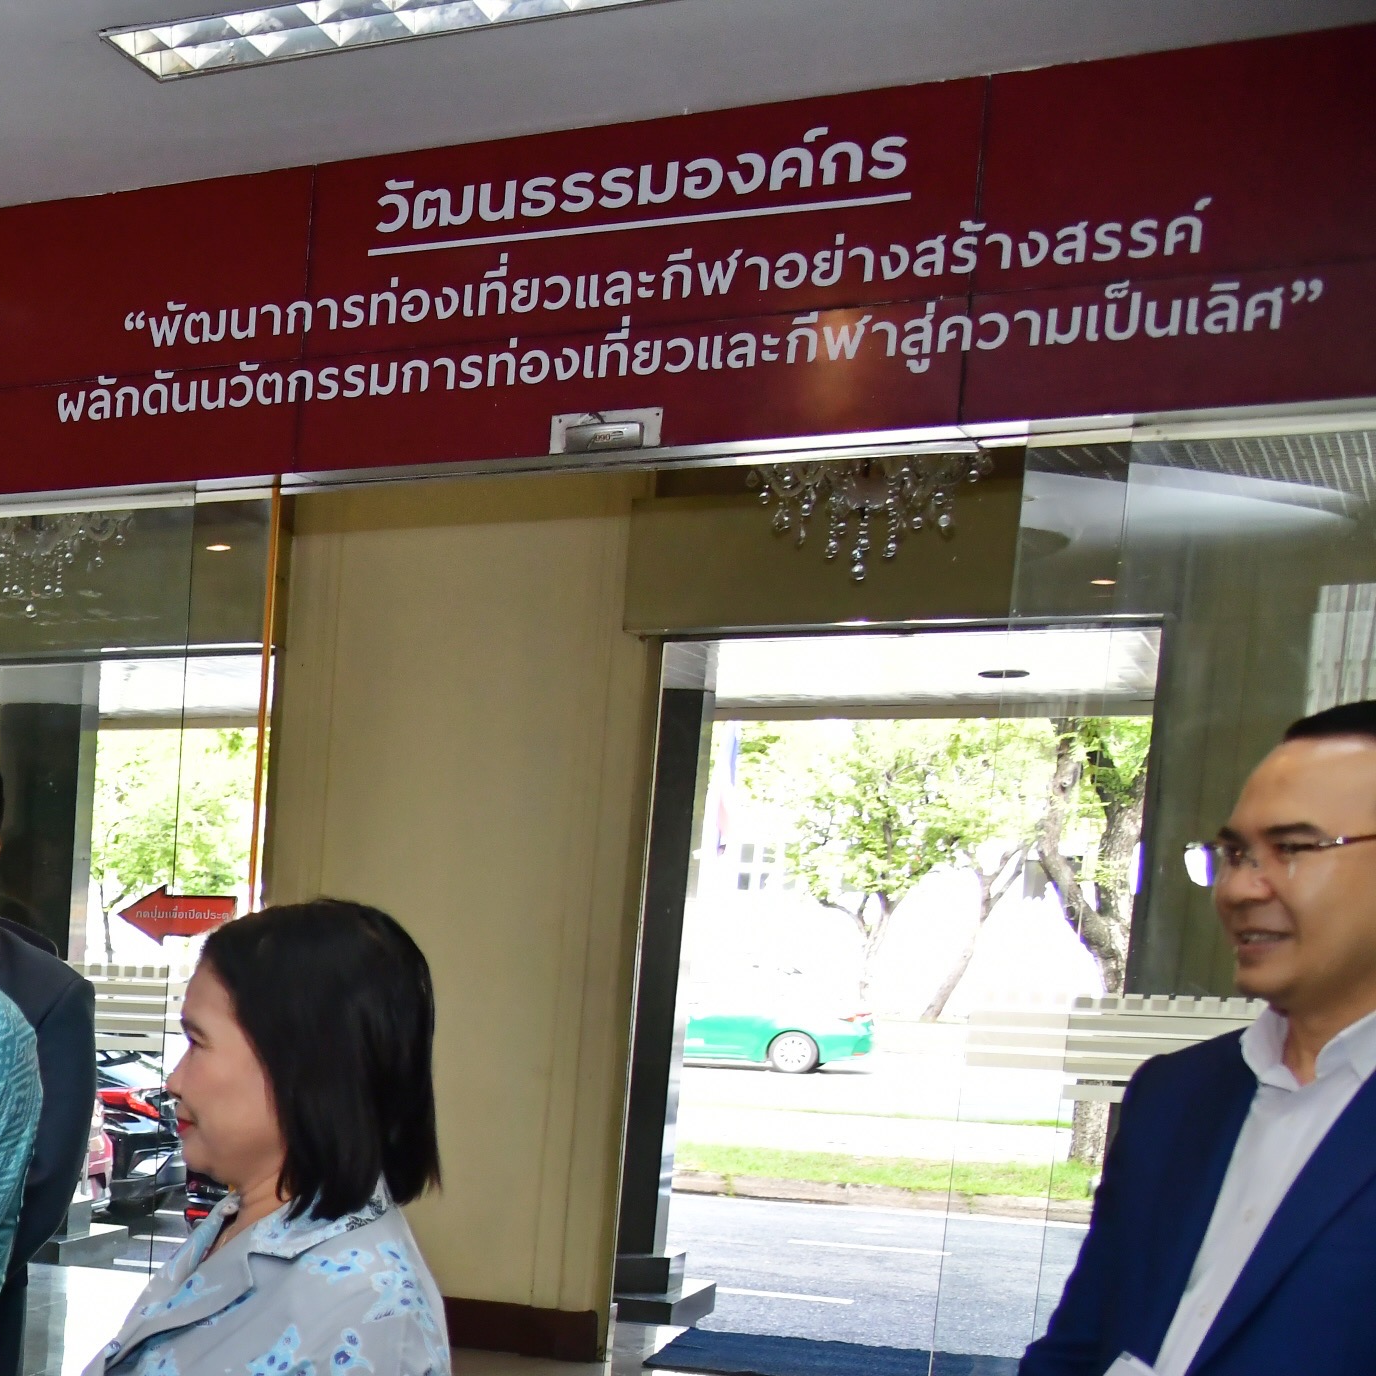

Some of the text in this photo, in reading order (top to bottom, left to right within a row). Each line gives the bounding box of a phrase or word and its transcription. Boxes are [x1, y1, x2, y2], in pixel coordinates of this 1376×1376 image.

[374, 126, 909, 233] วัฒนธรรมองค์กร
[123, 197, 1212, 348] “พัฒนาการท่องเที่ยวและกีฬาอย่างสร้างสรรค์
[57, 279, 1323, 423] ผลักดันนวัตกรรมการท่องเที่ยวและกีฬาสู่ความเป็นเลิศ”
